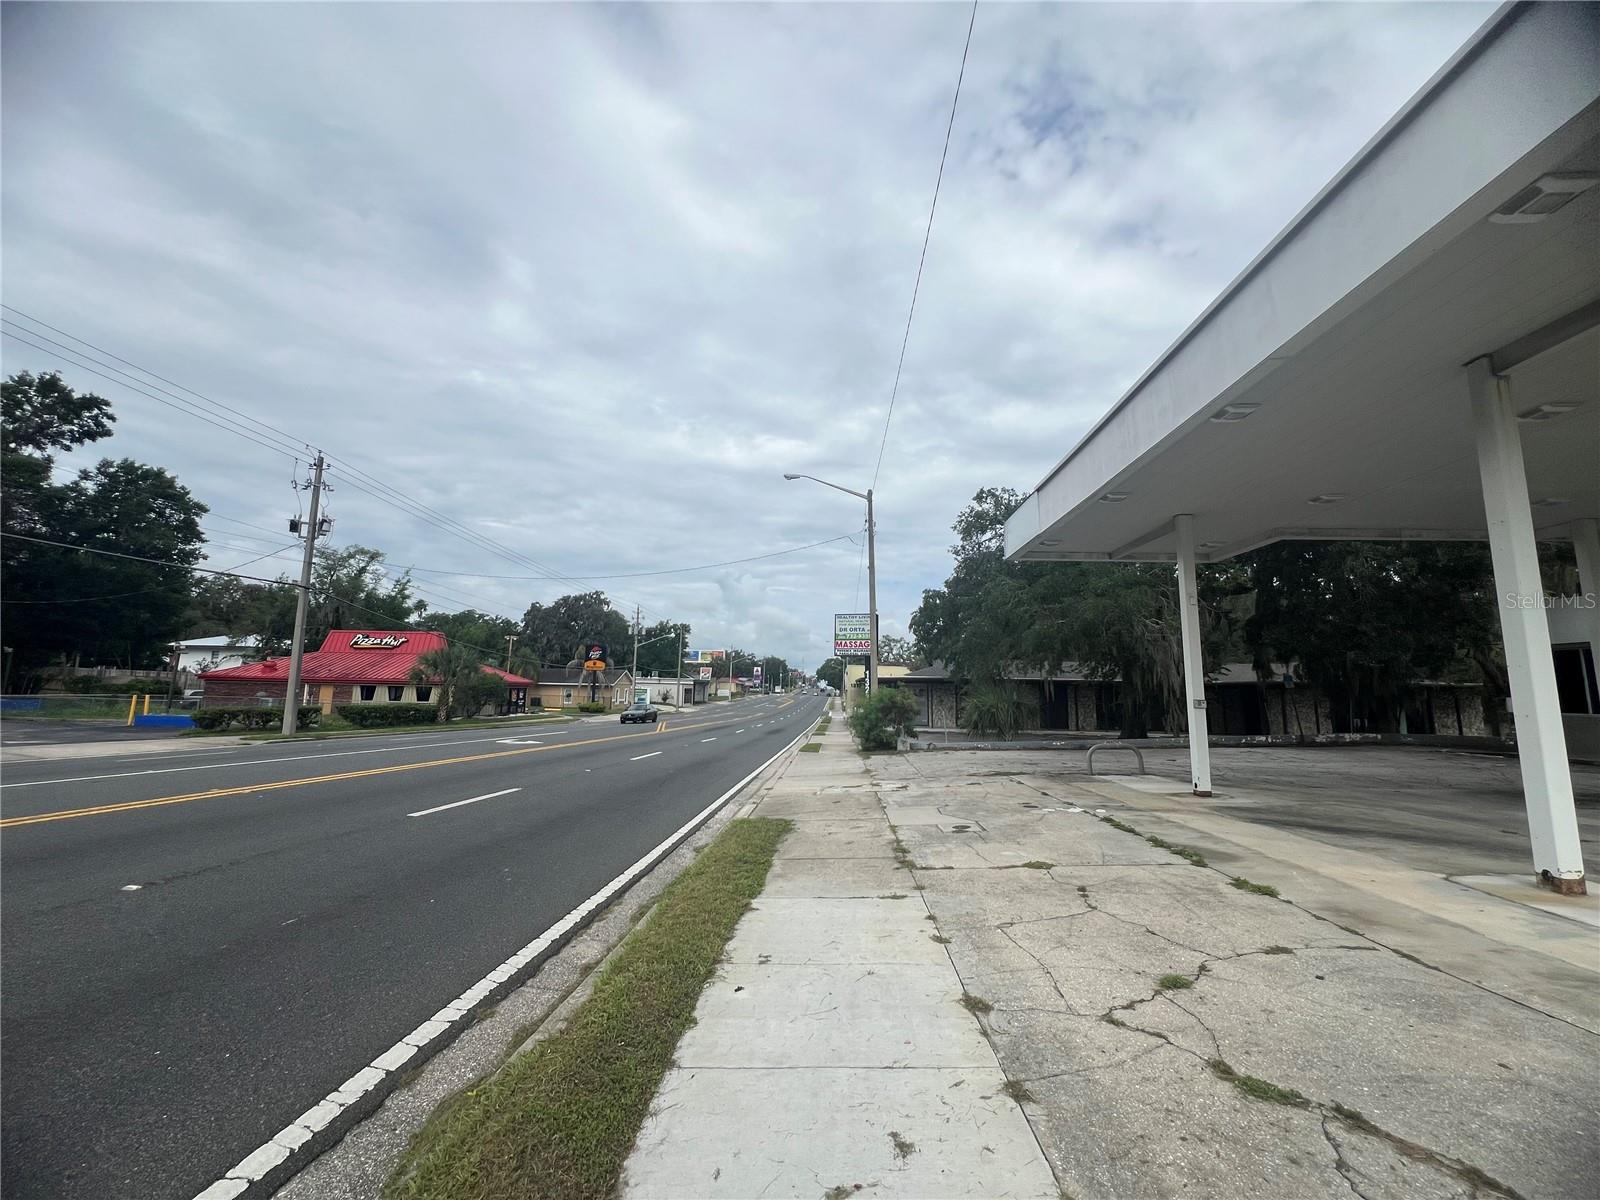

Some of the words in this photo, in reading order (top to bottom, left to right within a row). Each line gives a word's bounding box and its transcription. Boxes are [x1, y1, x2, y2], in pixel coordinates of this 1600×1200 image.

[350, 634, 381, 645] Pizza
[382, 635, 407, 646] Hut
[835, 640, 870, 648] MASSAG
